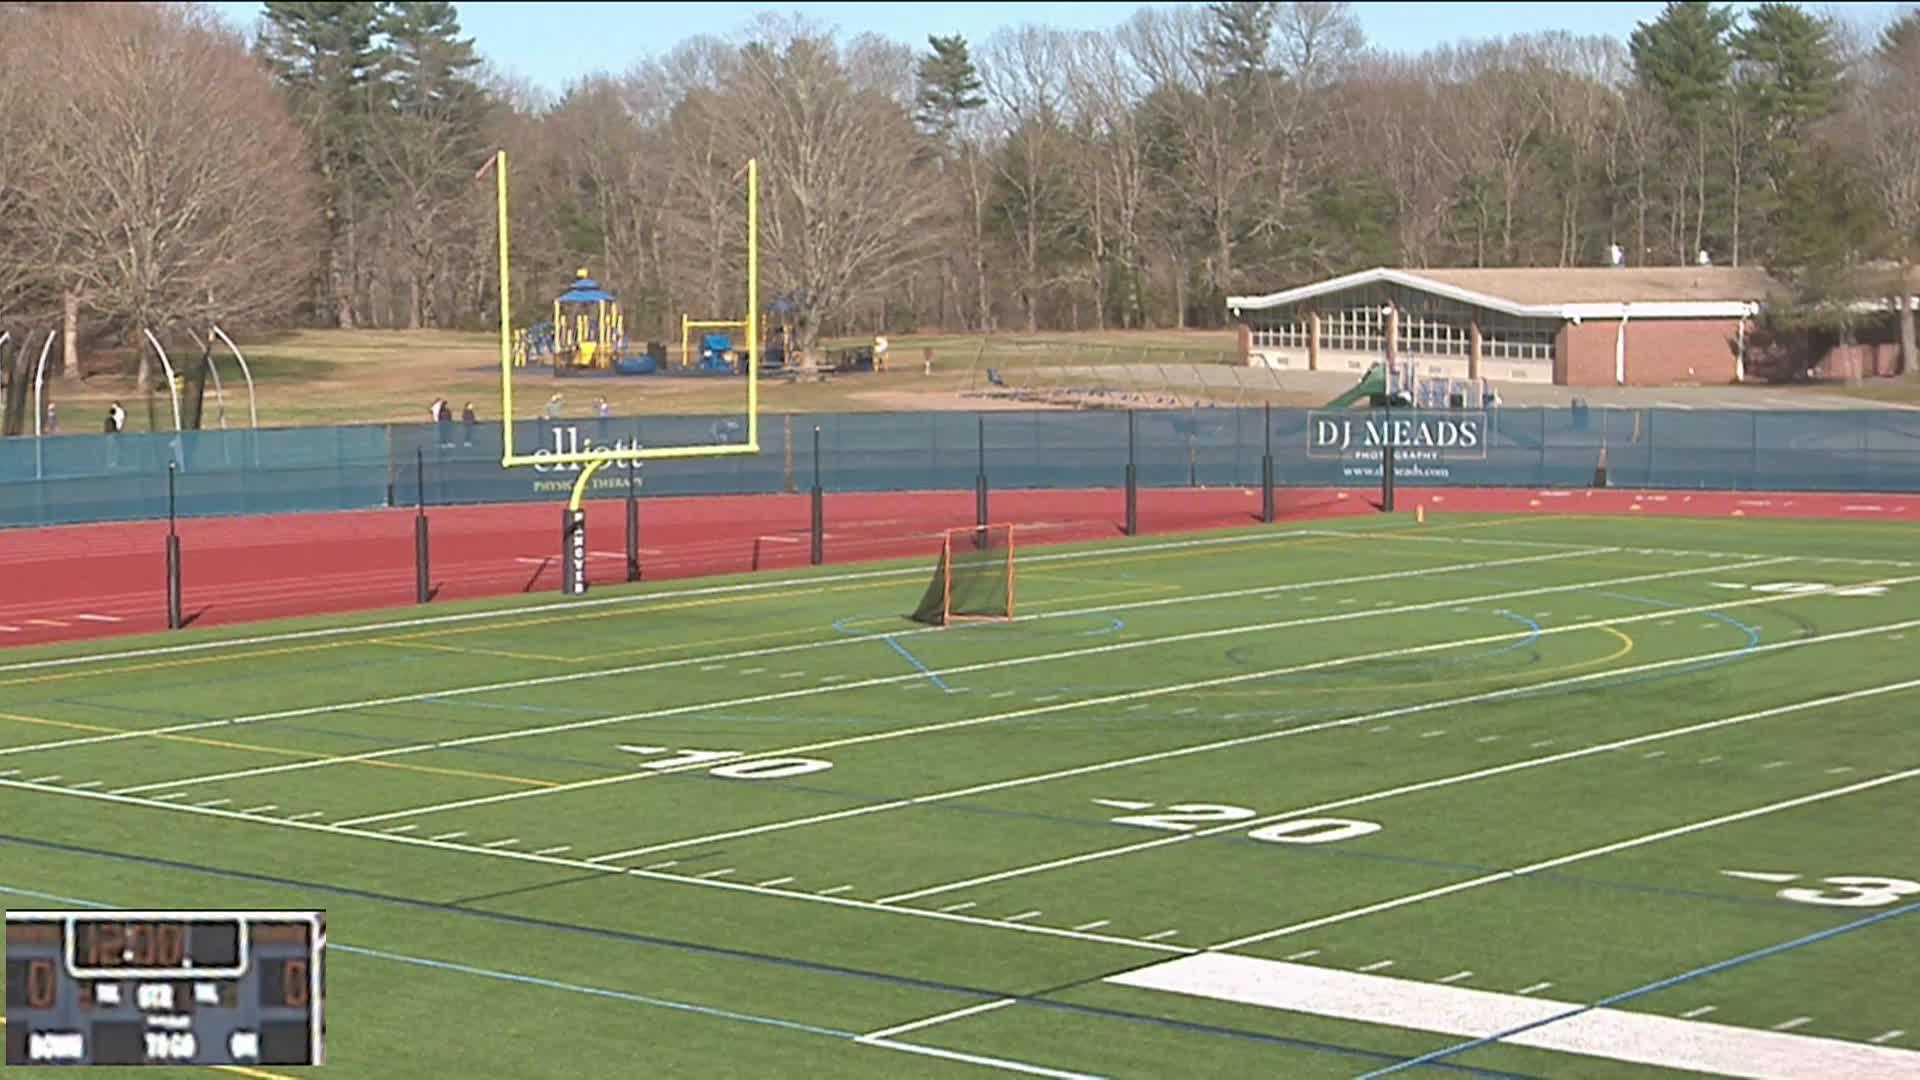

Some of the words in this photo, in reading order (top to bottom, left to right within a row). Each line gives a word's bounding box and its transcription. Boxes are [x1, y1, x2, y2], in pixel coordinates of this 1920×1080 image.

[533, 426, 645, 473] elliott
[1317, 420, 1351, 449] DJ
[1363, 419, 1478, 448] MEADS
[1355, 450, 1438, 460] PHOTGRAPHY
[1111, 803, 1383, 844] 20
